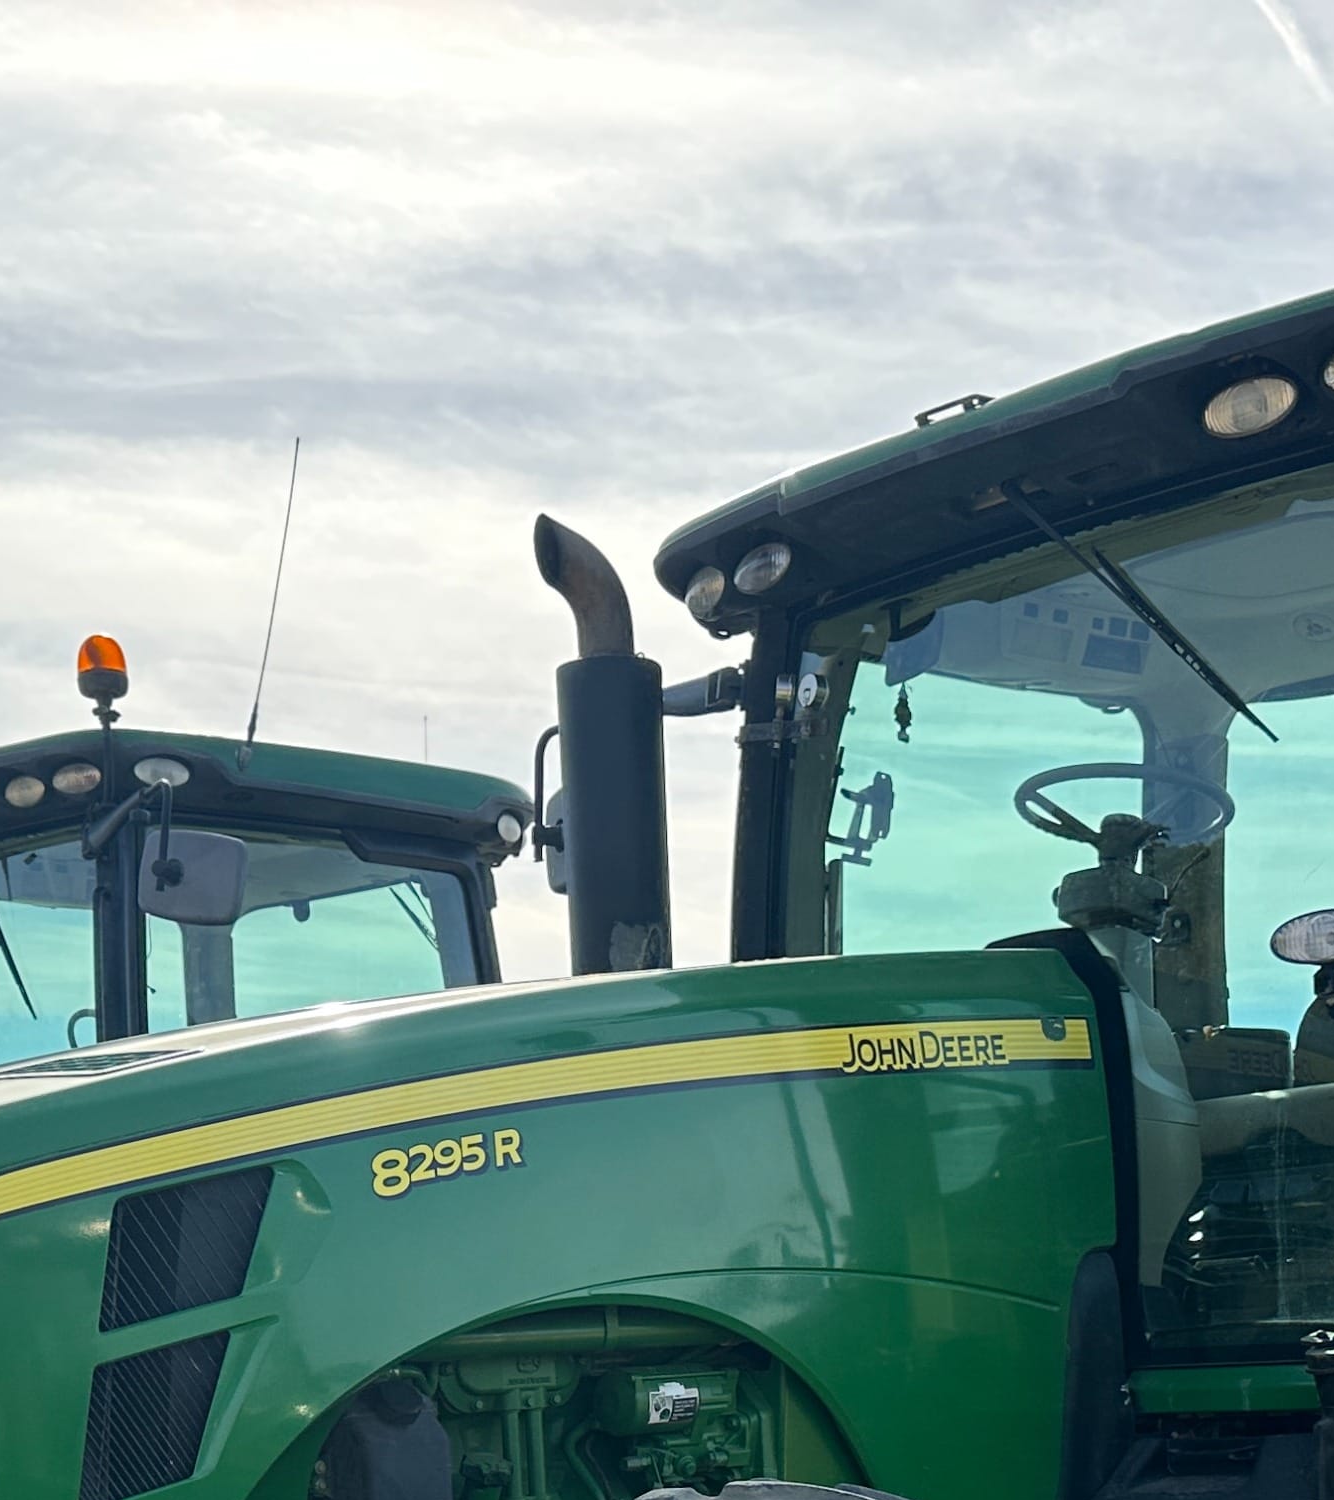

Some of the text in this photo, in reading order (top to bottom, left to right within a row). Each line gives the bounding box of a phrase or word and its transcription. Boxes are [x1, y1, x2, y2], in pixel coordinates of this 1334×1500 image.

[842, 1030, 1008, 1072] JOHN DEERE
[371, 1128, 524, 1197] 8295 R
